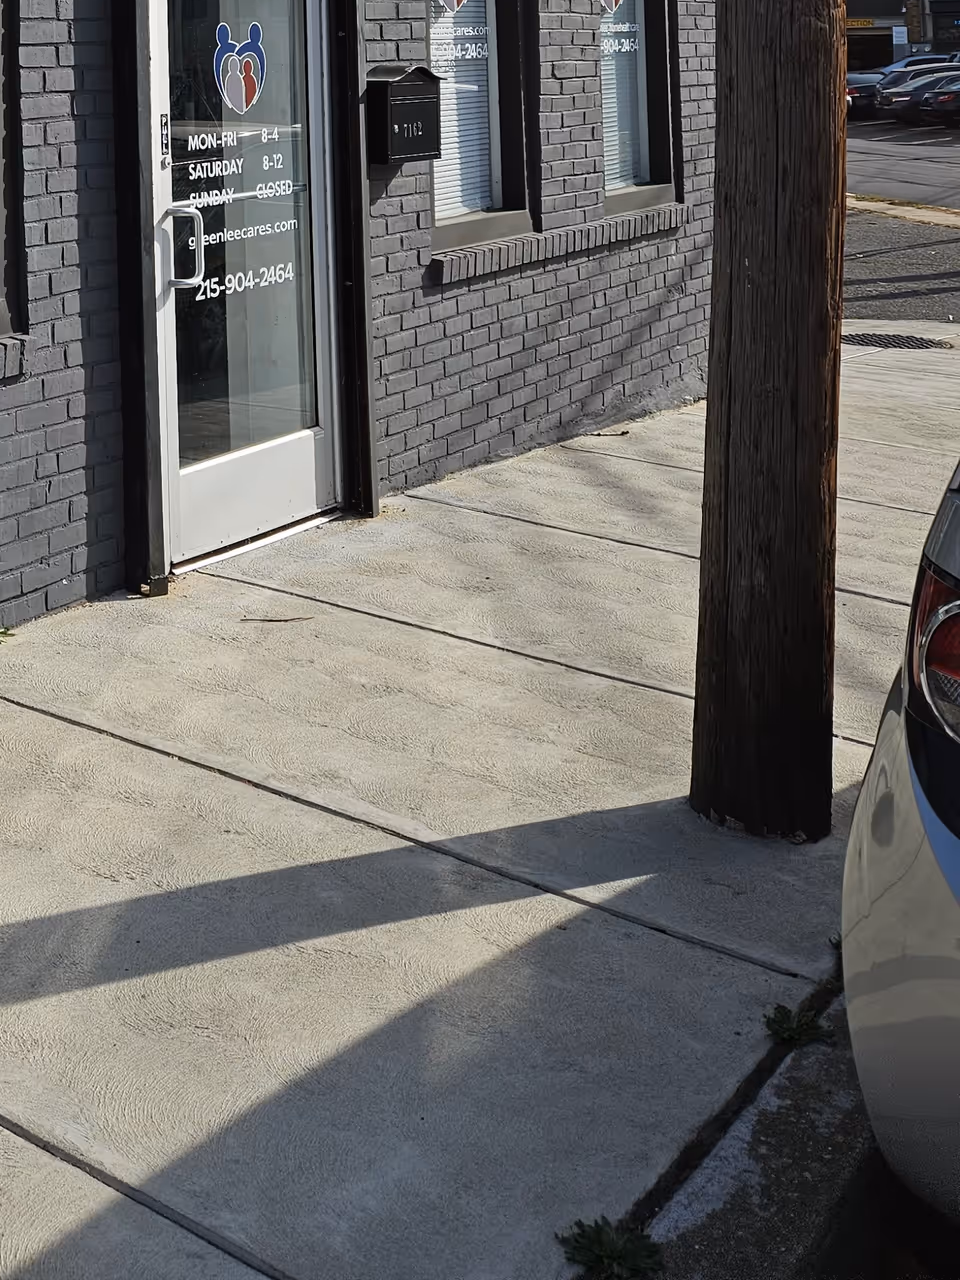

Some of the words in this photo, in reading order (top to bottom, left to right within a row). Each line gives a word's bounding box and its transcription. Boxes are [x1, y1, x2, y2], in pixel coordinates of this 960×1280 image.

[188, 130, 237, 152] MON-FRI
[261, 126, 279, 143] 8-4
[189, 158, 245, 180] SATURDAY
[262, 153, 283, 171] 8-12
[189, 187, 234, 209] SUNDAY
[256, 179, 293, 199] CLOSED
[188, 219, 298, 250] geenleecares.com
[195, 262, 294, 301] 215-904-2464
